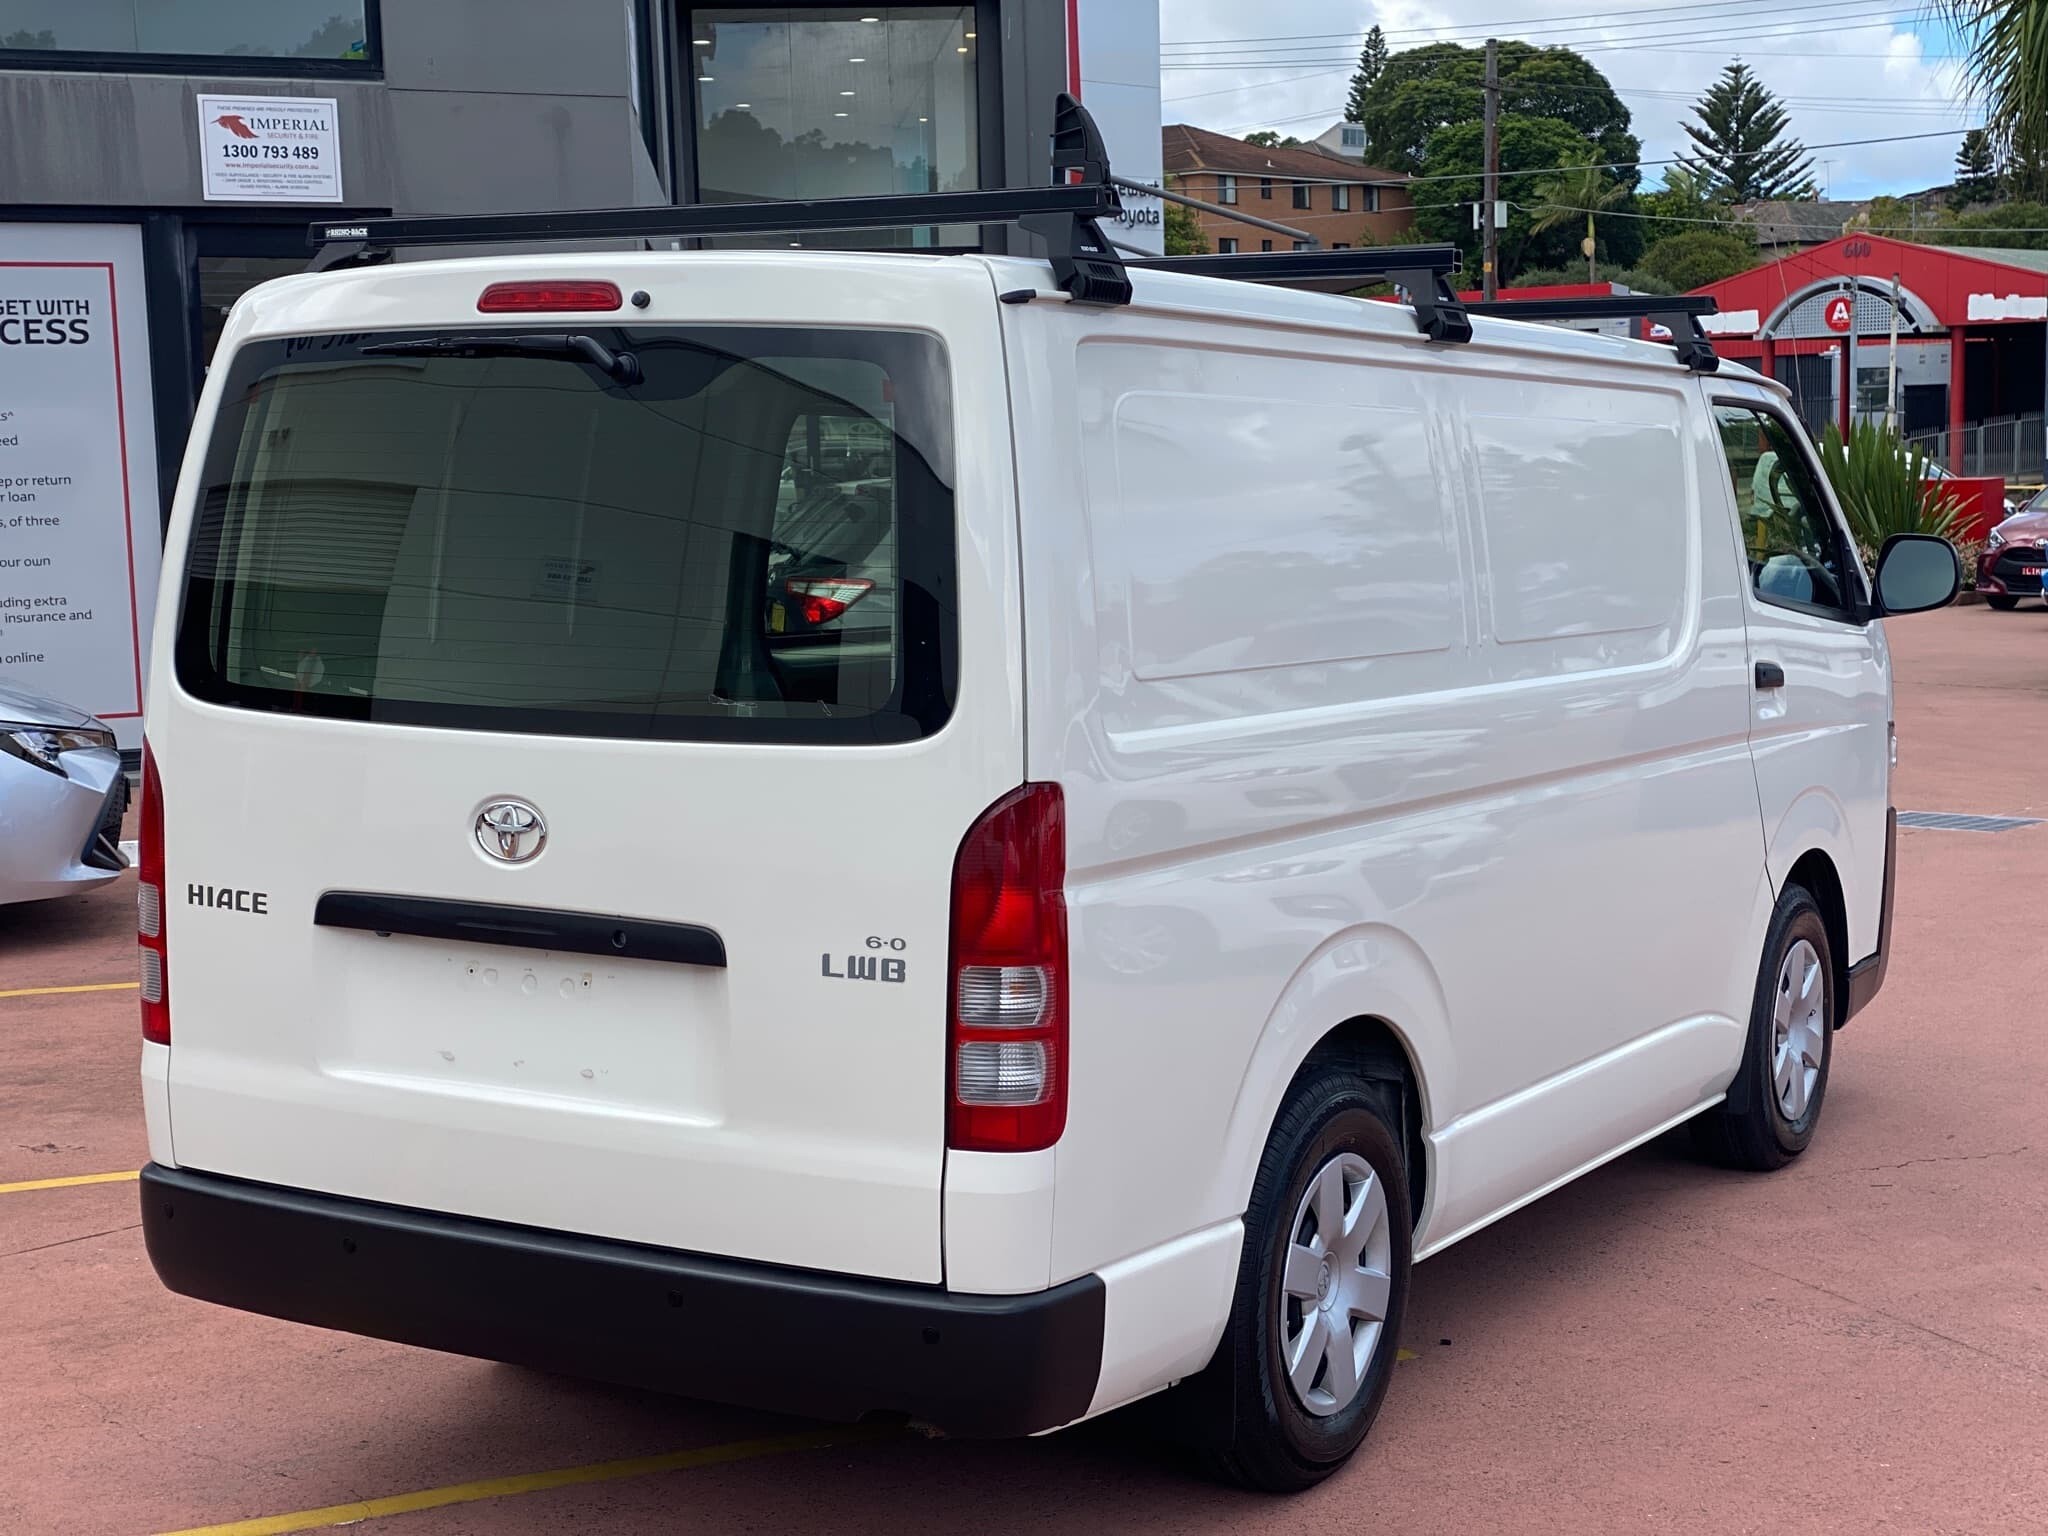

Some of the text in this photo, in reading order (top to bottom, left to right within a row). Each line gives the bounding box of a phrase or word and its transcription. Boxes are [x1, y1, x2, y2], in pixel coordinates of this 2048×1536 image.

[250, 118, 329, 132] IMPERIAL
[222, 144, 319, 160] 1300 793 489
[1114, 207, 1160, 228] oyota
[36, 299, 90, 316] WITH
[15, 477, 29, 488] or
[32, 475, 72, 487] return
[8, 491, 36, 503] loan
[9, 515, 23, 528] of
[26, 514, 60, 527] three
[24, 557, 51, 568] own
[34, 595, 68, 607] extra
[4, 609, 93, 624] insurance and
[5, 652, 45, 664] online
[188, 883, 268, 915] HIACE
[822, 953, 906, 983] LWB
